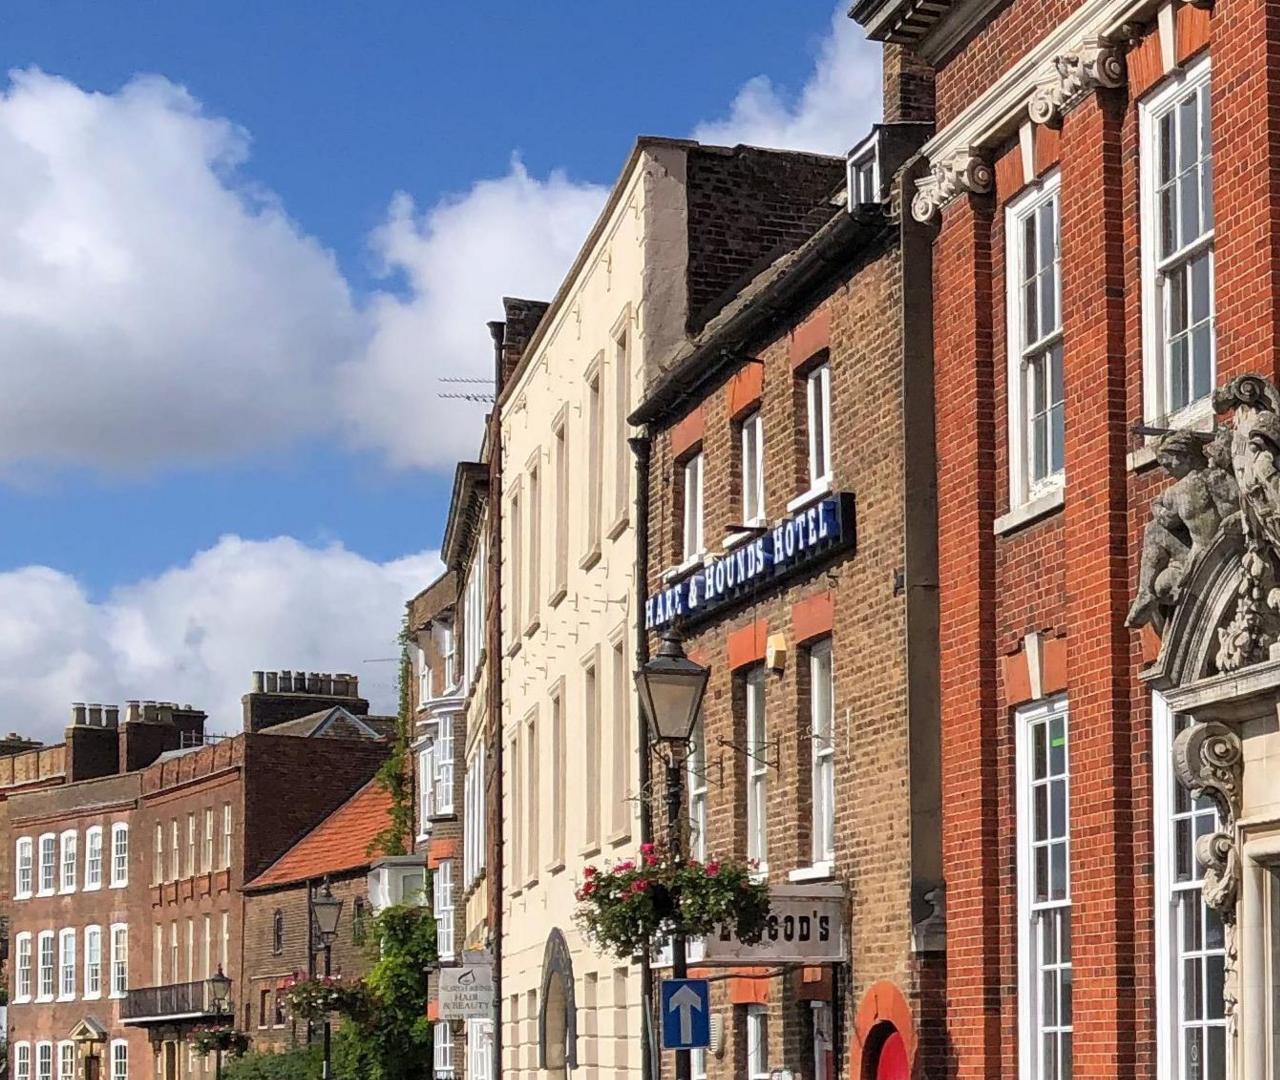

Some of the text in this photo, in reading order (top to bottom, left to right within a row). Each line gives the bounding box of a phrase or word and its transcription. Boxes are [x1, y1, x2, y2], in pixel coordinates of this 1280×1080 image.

[645, 502, 828, 630] HARE & HOUNDS HOTEL
